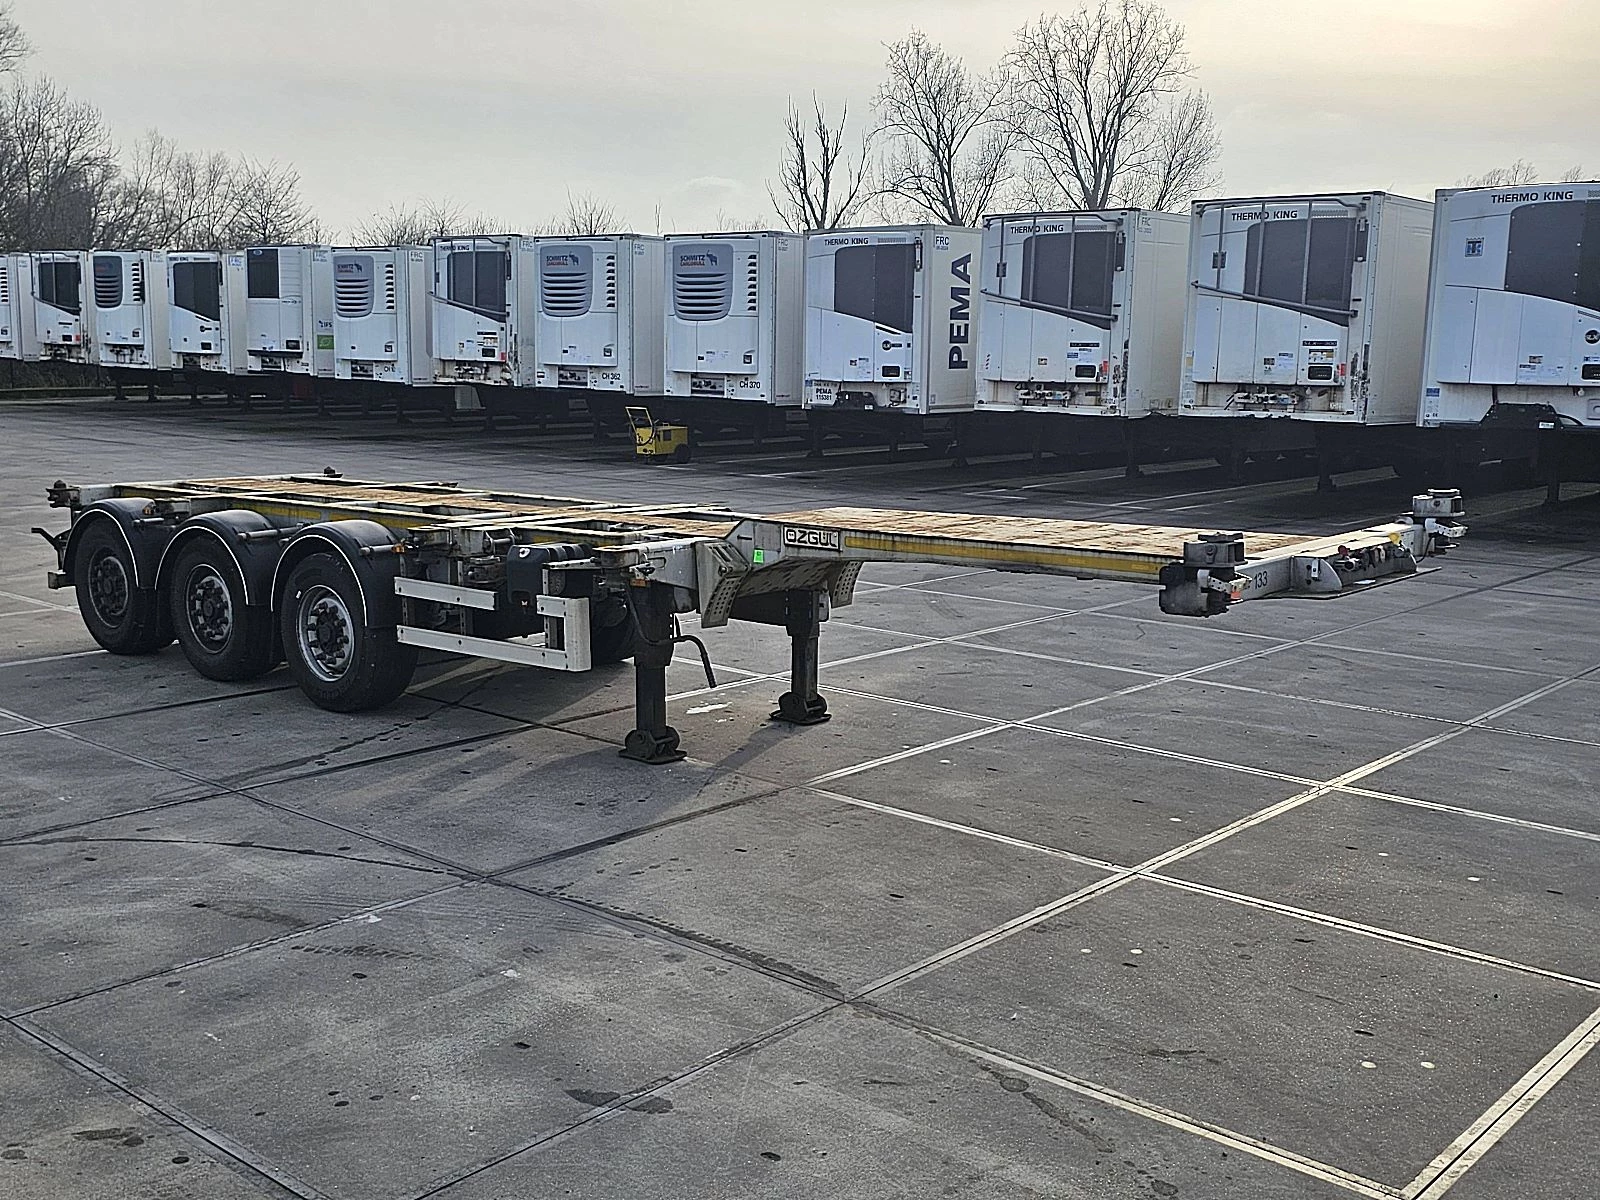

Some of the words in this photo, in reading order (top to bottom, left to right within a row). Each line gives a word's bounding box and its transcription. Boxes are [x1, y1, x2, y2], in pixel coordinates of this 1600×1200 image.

[1491, 192, 1539, 203] THERMO
[1544, 191, 1574, 201] KING
[1232, 211, 1270, 221] THERMO
[1274, 210, 1298, 219] KING
[1011, 225, 1041, 234] THERMO
[1044, 224, 1064, 232] KING
[936, 236, 949, 245] FRC
[949, 253, 972, 370] PEMA
[1254, 571, 1268, 590] 133
